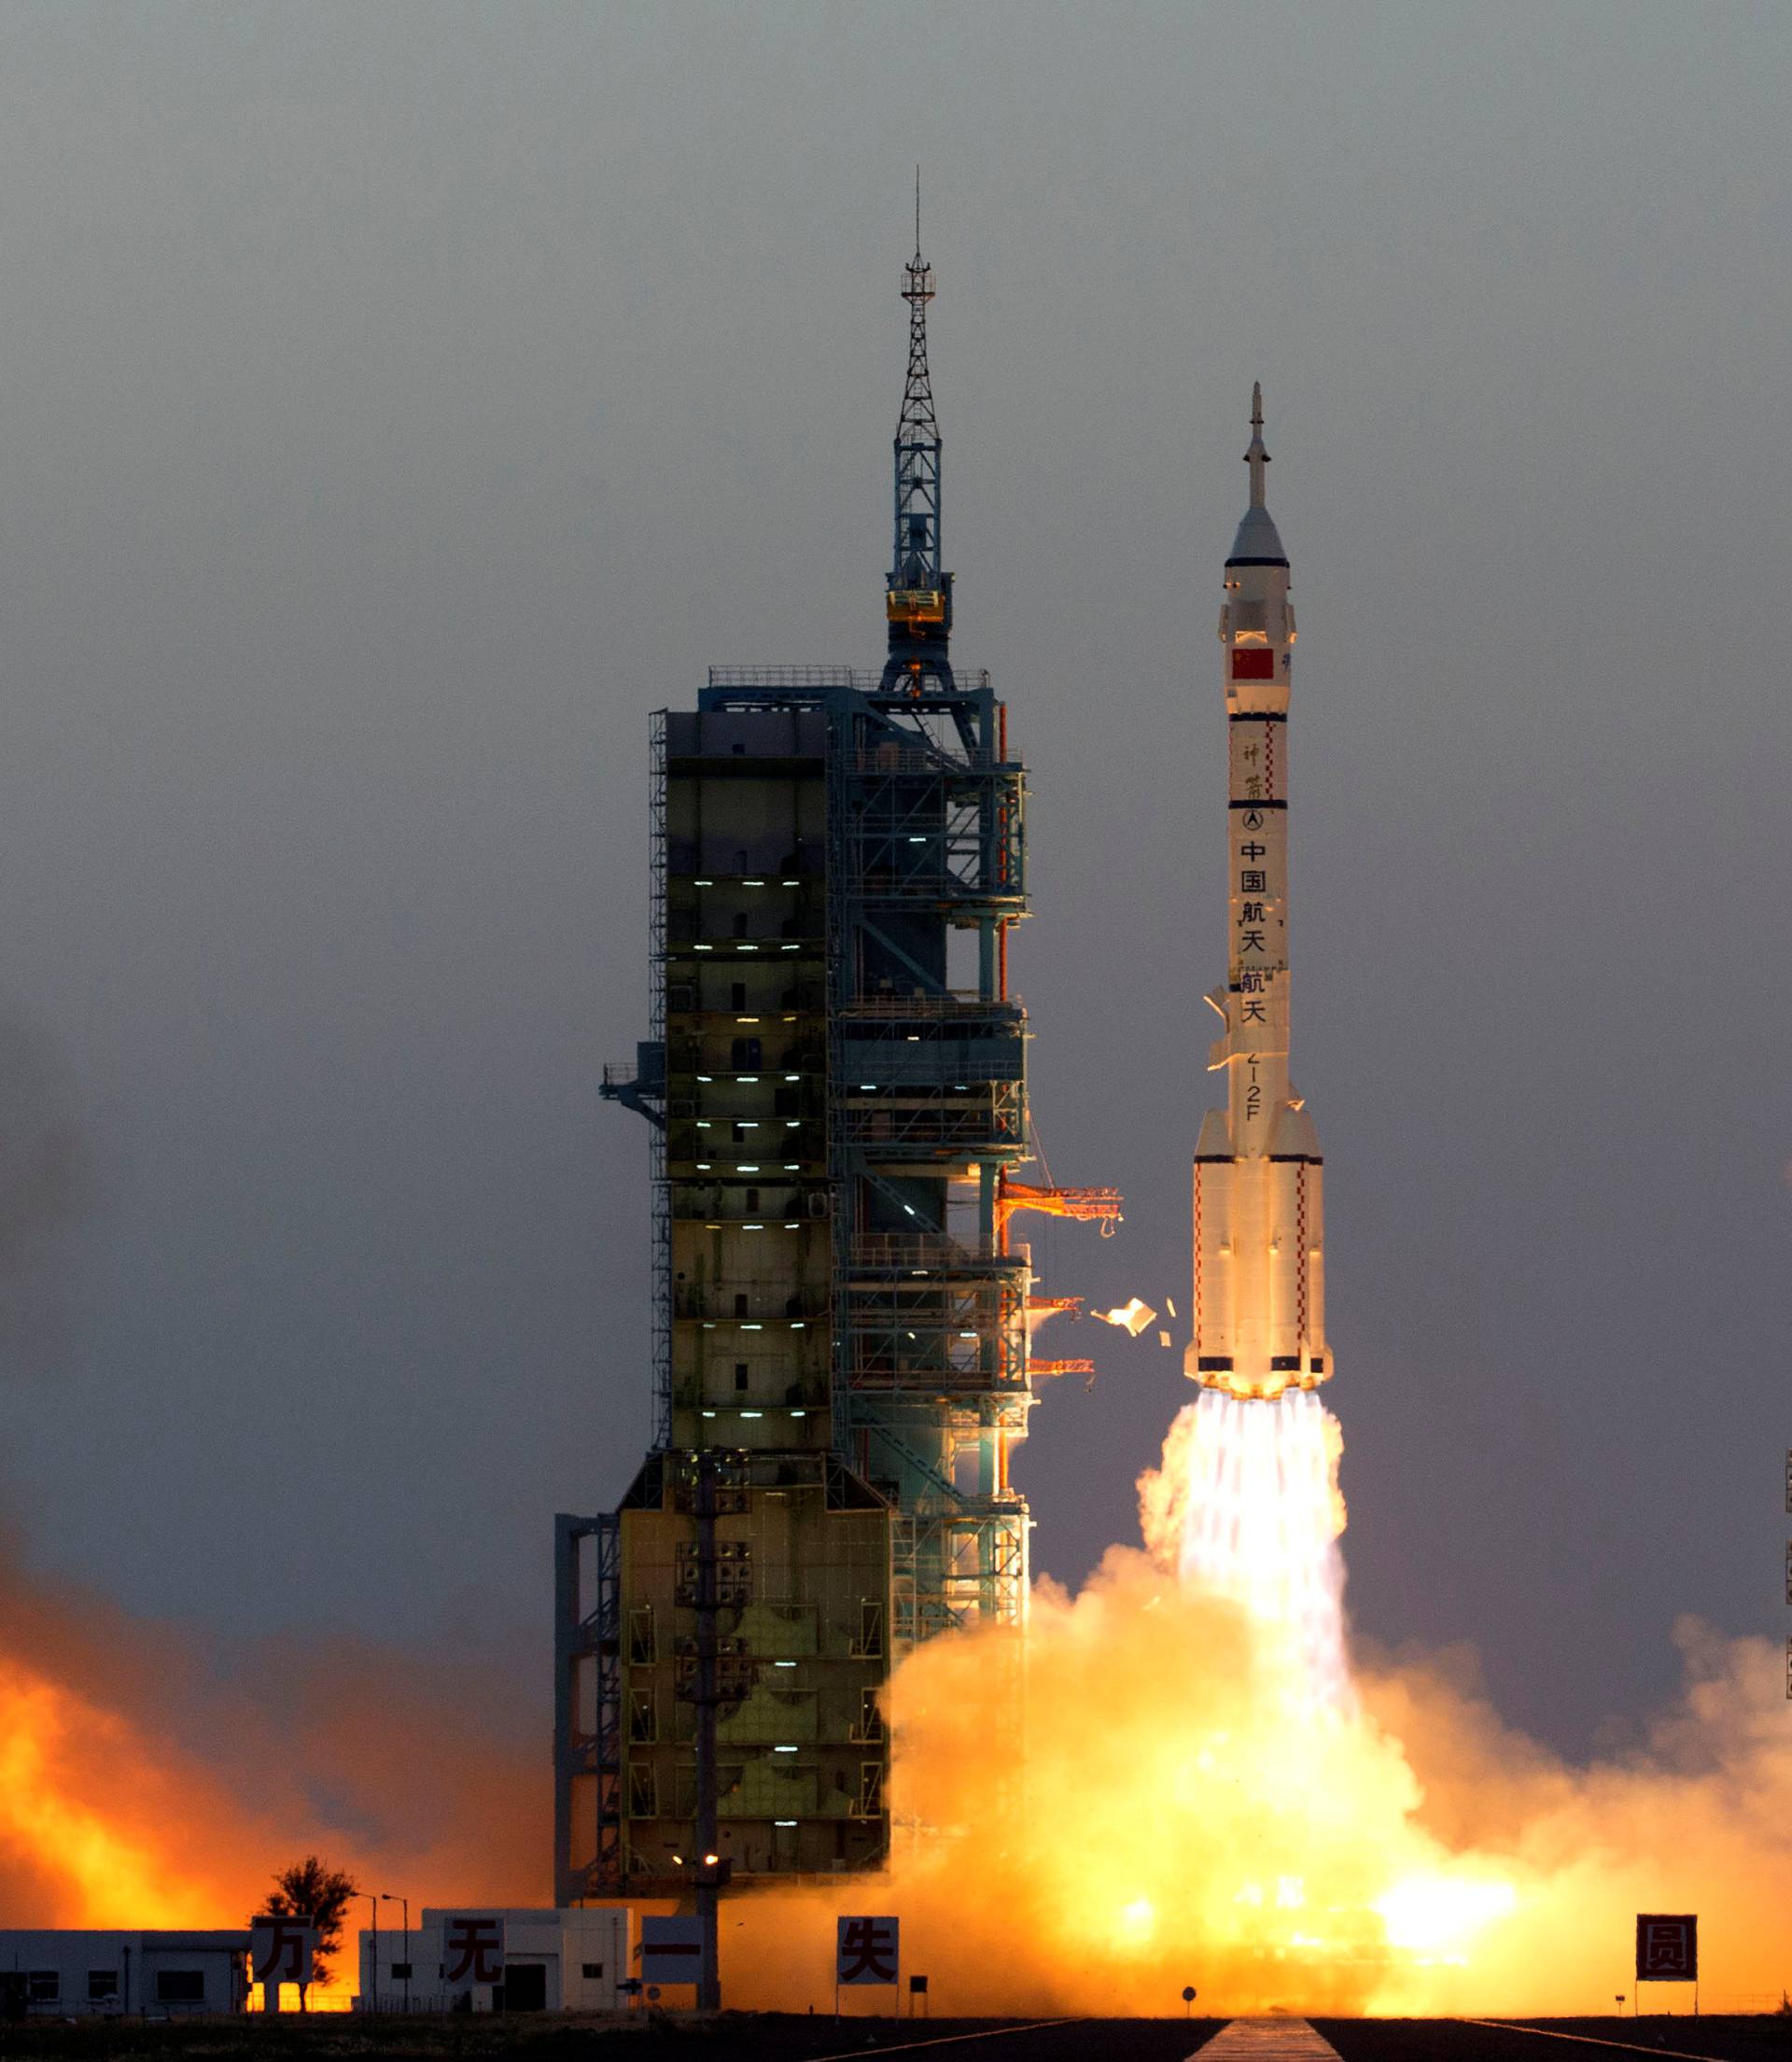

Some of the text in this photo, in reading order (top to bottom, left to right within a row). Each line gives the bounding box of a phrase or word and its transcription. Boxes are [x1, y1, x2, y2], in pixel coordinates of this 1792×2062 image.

[1240, 841, 1266, 952] 中国航天
[1242, 973, 1267, 1022] 航天
[254, 1917, 312, 1980] 万
[447, 1919, 502, 1982] 无
[644, 1944, 701, 1955] 一
[841, 1919, 897, 1982] 失
[1638, 1915, 1694, 1976] 圆
